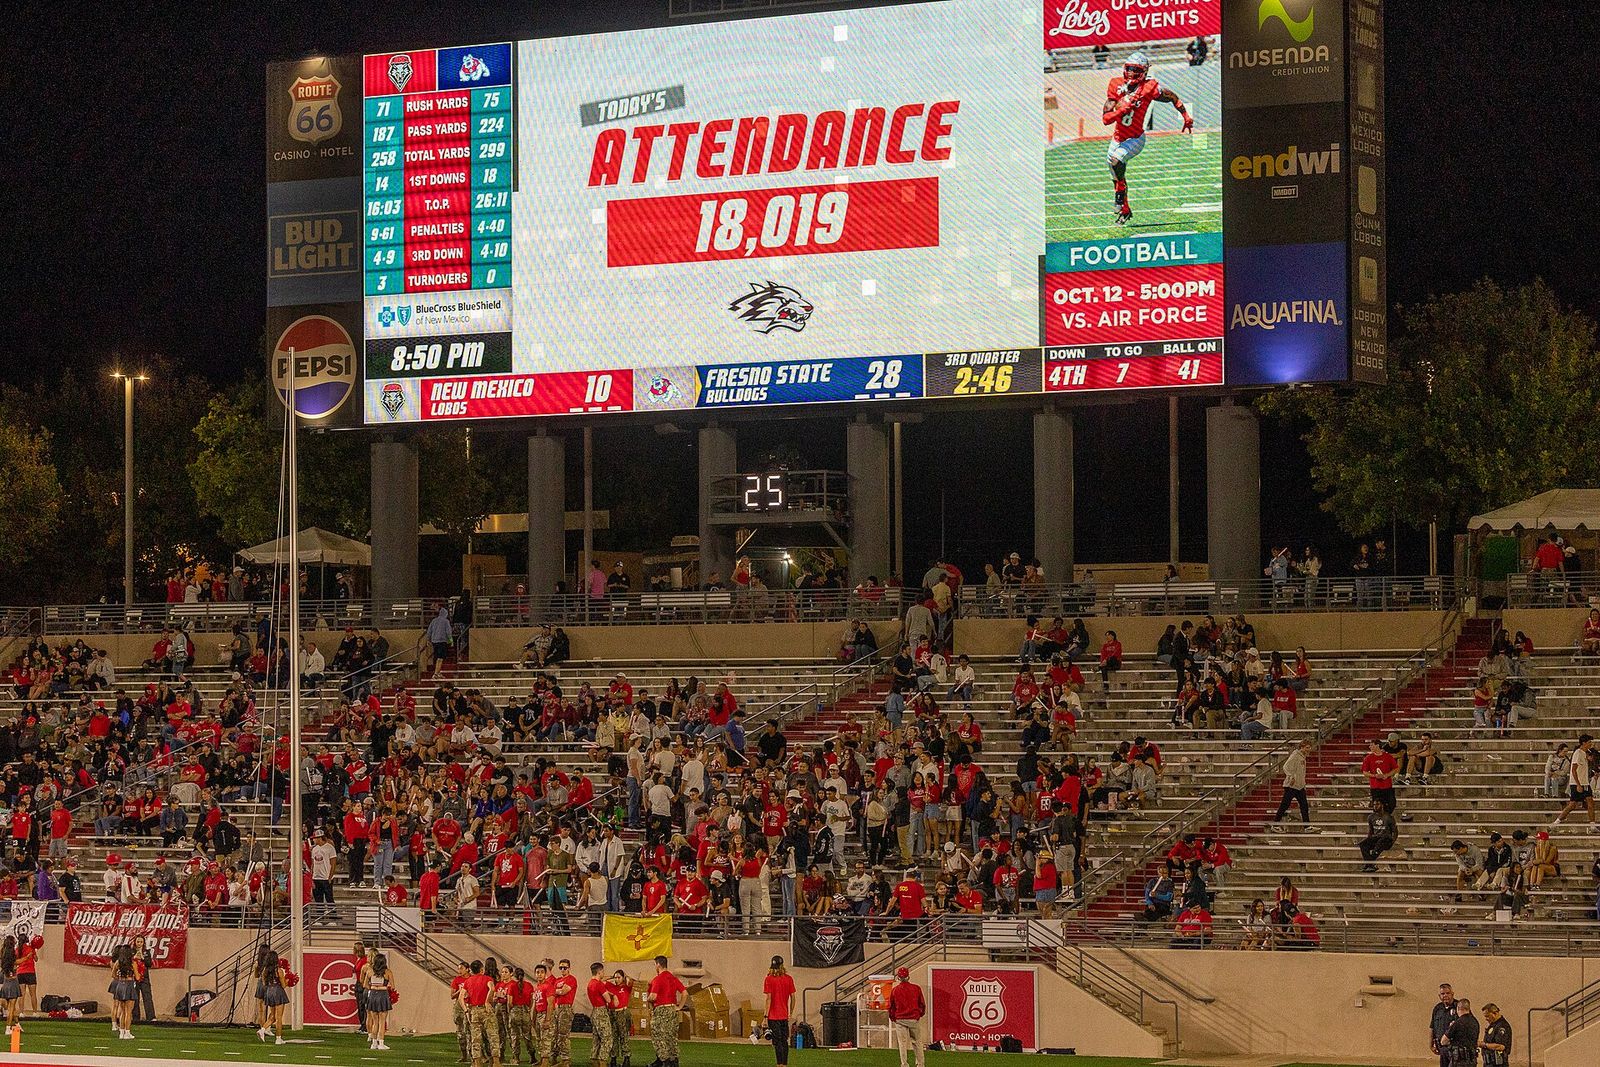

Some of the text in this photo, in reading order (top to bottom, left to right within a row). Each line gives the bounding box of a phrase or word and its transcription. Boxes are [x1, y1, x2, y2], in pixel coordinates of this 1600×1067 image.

[1111, 0, 1213, 10] UPCO
[1049, 0, 1111, 37] Lobos
[1126, 9, 1199, 30] EVENTS
[1230, 46, 1329, 69] NUSENDA
[1272, 66, 1330, 77] CREDIT UNION
[298, 84, 332, 98] ROUTE
[406, 97, 468, 112] RUSH YARDS
[483, 92, 500, 108] 75
[598, 90, 666, 122] TODAY'S
[376, 102, 390, 116] 71
[296, 105, 334, 133] 66
[479, 117, 504, 133] 224
[1358, 111, 1376, 125] NEW
[372, 126, 395, 142] 187
[408, 122, 468, 137] PASS YARDS
[1351, 124, 1382, 141] MEXICO
[479, 142, 506, 158] 299
[586, 100, 960, 187] ATTENDANCE
[1353, 139, 1380, 156] LOBOS
[274, 146, 354, 161] CASINO HOTEL
[371, 151, 396, 166] 258
[404, 147, 470, 162] TOTAL YARDS
[1230, 143, 1340, 180] endwi
[376, 176, 388, 192] 14
[410, 172, 466, 187] 1ST DOWNS
[483, 168, 497, 184] 18
[475, 192, 508, 208] 26:11
[1273, 188, 1296, 196] NMDOT
[368, 200, 402, 216] 16:03
[425, 199, 450, 210] T.O.P.
[411, 223, 464, 236] PENALTIES
[694, 191, 849, 256] 18,019
[285, 219, 342, 245] BUD
[1354, 231, 1382, 246] LOBOS
[274, 242, 354, 270] LIGHT
[412, 248, 464, 262] 3RD DOWN
[1070, 240, 1198, 266] FOOTBALL
[377, 276, 388, 290] 3
[408, 273, 468, 286] TURNOVERS
[486, 269, 496, 284] 0
[1053, 280, 1216, 304] OCT. 12 5:00PM
[416, 300, 501, 314] BlueCross BlueShield
[1230, 300, 1339, 330] AQUAFINA
[416, 314, 470, 326] of New Mexico
[1062, 306, 1208, 329] VS. AIR FORCE
[1360, 326, 1378, 338] NEW
[1049, 348, 1086, 360] DOWN
[1104, 345, 1142, 358] TO GO
[1163, 342, 1216, 354] BALL ON
[1354, 340, 1384, 354] MEXICO
[391, 342, 485, 371] 8:50 PM
[945, 350, 1020, 367] 3RD QUARTER
[1356, 354, 1383, 370] LOBOS
[278, 355, 350, 378] PEPSI
[1116, 363, 1130, 383] 7
[1178, 360, 1200, 380] 41
[705, 363, 834, 388] FRESNO STATE
[866, 360, 903, 390] 28
[954, 365, 1014, 394] 2:46
[1048, 366, 1088, 386] 4TH
[431, 378, 534, 400] NEW MEXICO
[584, 374, 612, 404] 10
[706, 387, 768, 403] BULLDOGS
[430, 402, 467, 416] LOBOS
[744, 476, 782, 506] 25
[71, 911, 184, 930] NORTH END ZONE
[77, 934, 170, 958] HOWRS
[320, 984, 356, 996] PEPS
[872, 984, 882, 996] G
[969, 984, 998, 994] ROUTE
[968, 1000, 998, 1020] 66
[949, 1032, 1014, 1041] CASINO HOT
